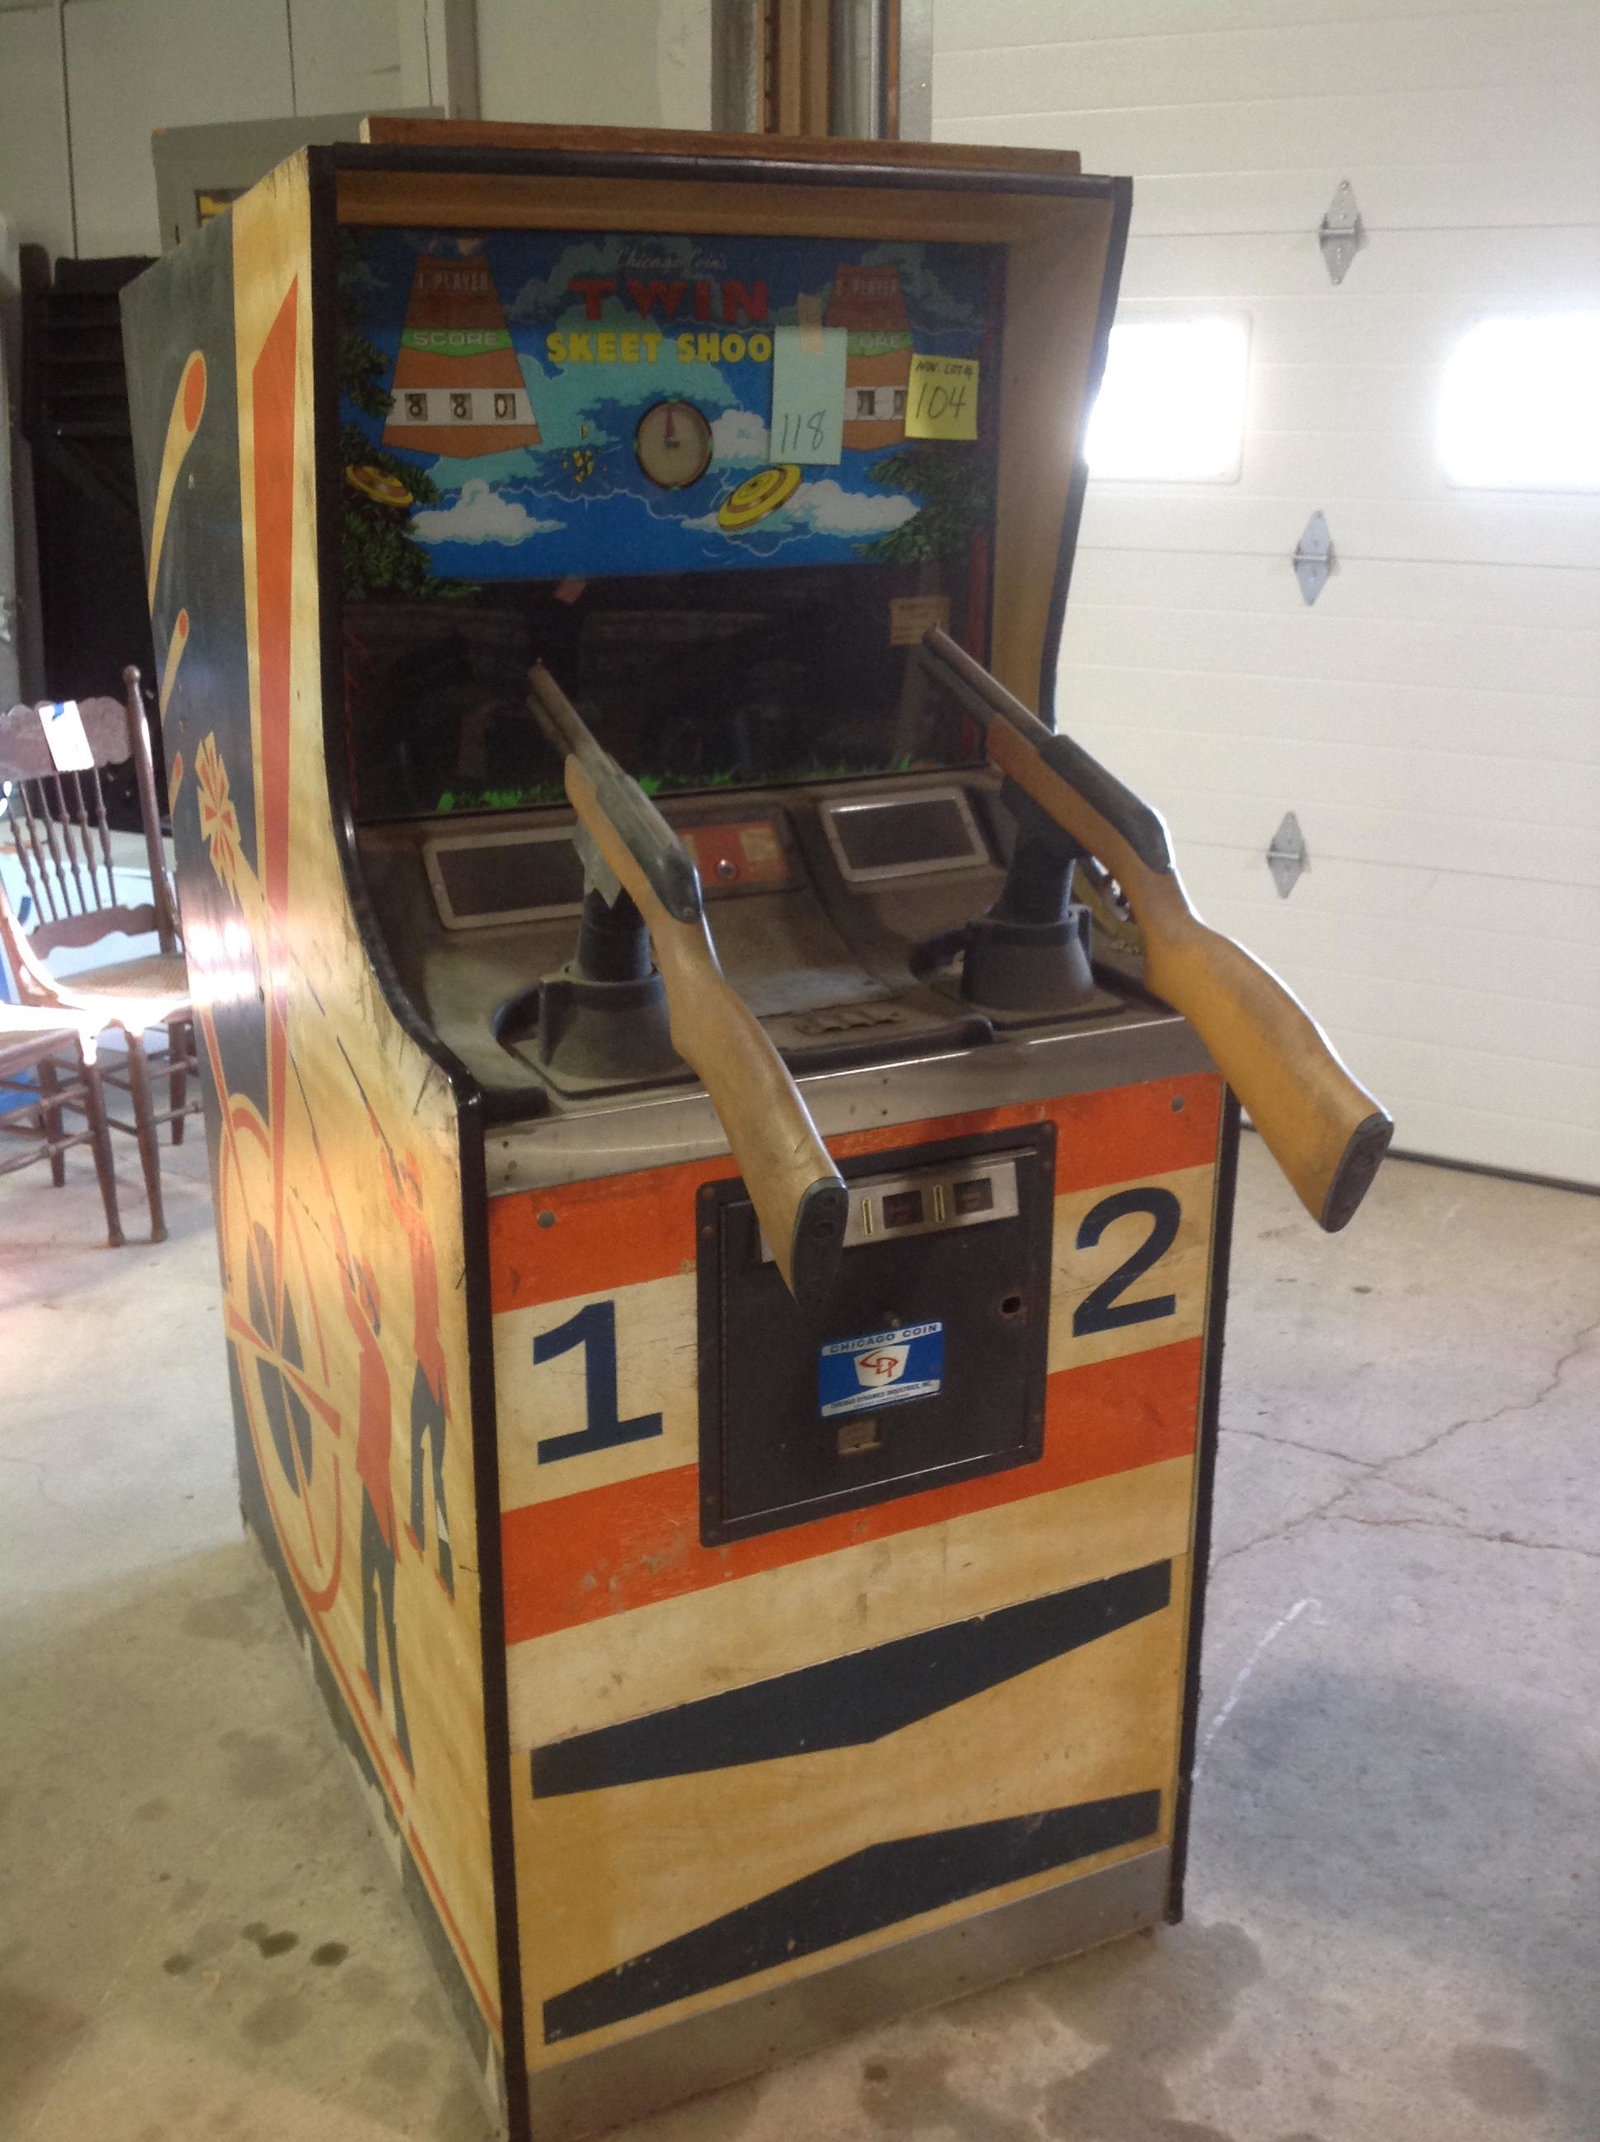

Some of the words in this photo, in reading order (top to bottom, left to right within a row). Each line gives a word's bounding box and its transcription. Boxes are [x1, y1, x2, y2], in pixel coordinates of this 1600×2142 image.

[433, 271, 490, 291] PLAYER
[567, 278, 769, 322] TWIN
[413, 331, 498, 346] SCORE
[546, 332, 664, 364] SKEET
[676, 332, 773, 364] SHOO
[915, 382, 967, 420] 104
[781, 409, 827, 455] 118
[1072, 1187, 1182, 1337] 2
[829, 1333, 896, 1354] CHICAGO
[902, 1324, 938, 1339] COIN
[532, 1300, 663, 1465] 1
